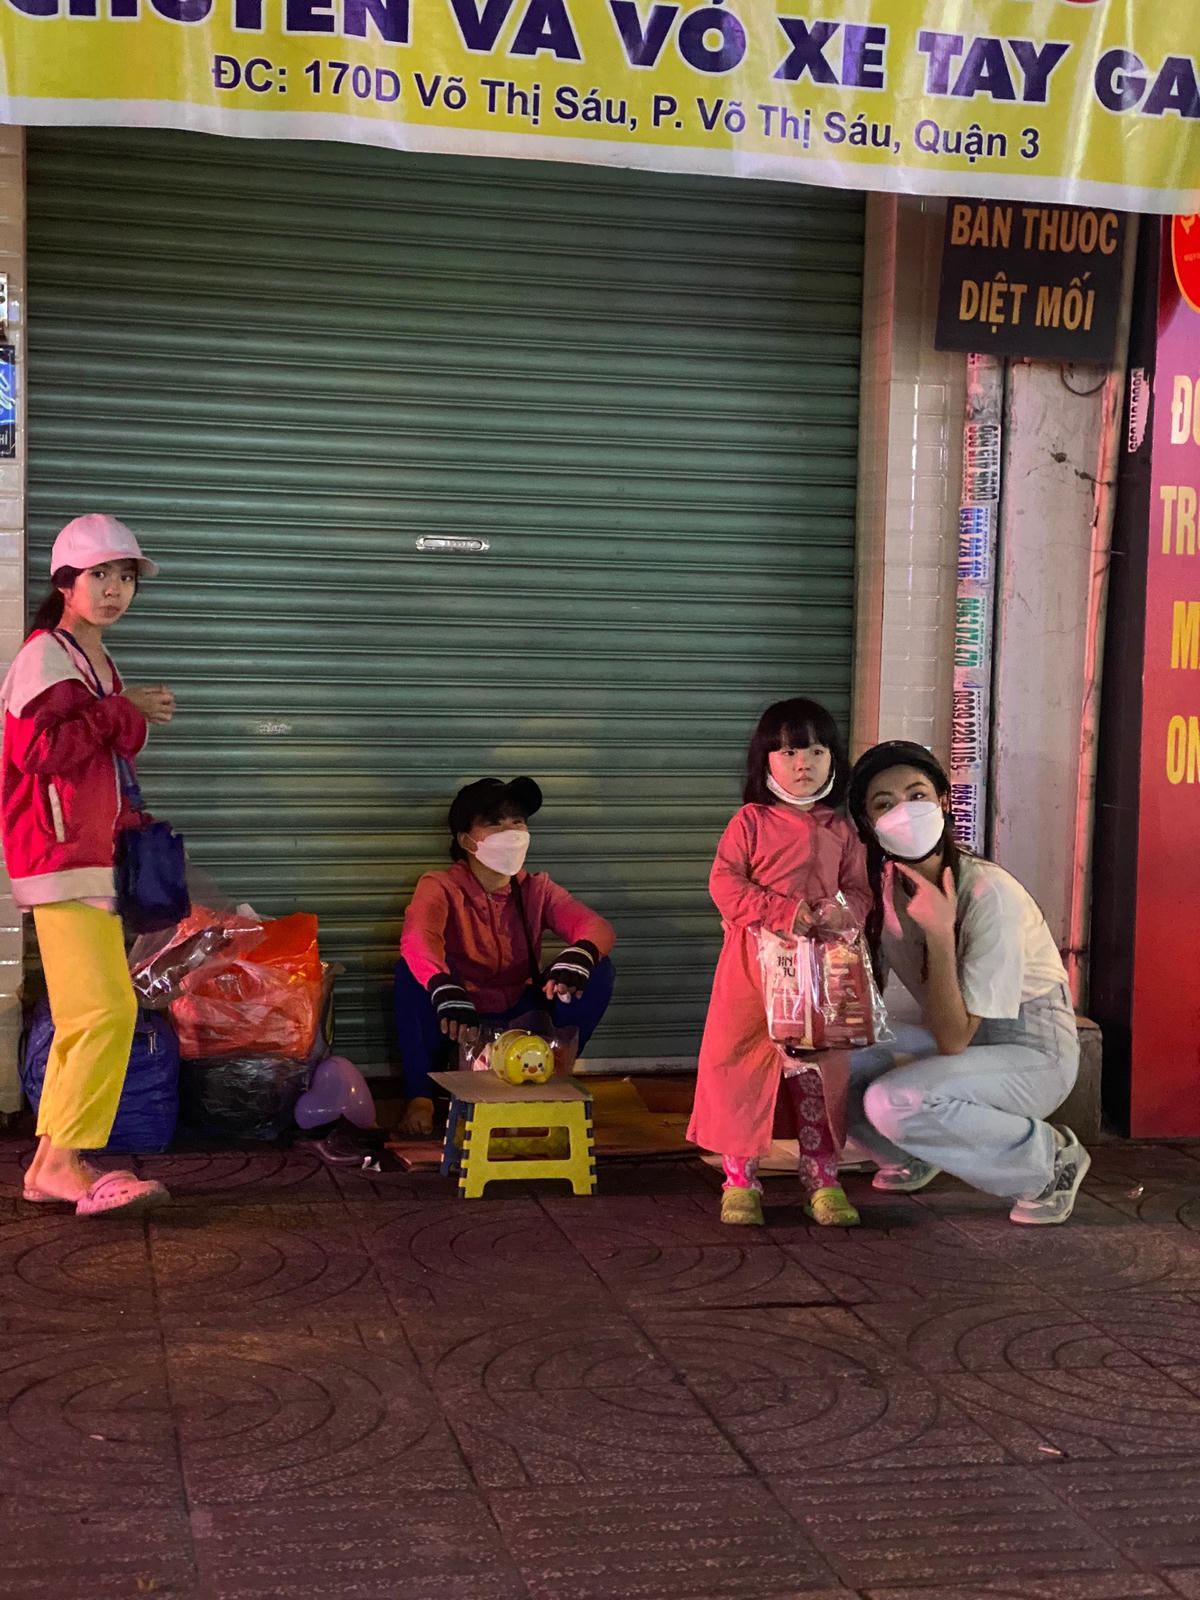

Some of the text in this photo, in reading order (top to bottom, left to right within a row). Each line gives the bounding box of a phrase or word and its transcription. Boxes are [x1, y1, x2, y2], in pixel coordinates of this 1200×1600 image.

[773, 17, 888, 89] XE
[918, 31, 1071, 103] TAY
[1094, 48, 1200, 118] GA
[211, 54, 1039, 163] ĐC: 170D Võ Thị Sáu, P. Võ Thị Sáu, Quận 3
[958, 271, 1096, 335] DIỆT MỐI
[1159, 485, 1200, 556] TR
[951, 721, 977, 744] 228
[952, 690, 976, 720] 0939
[951, 783, 973, 806] 0896
